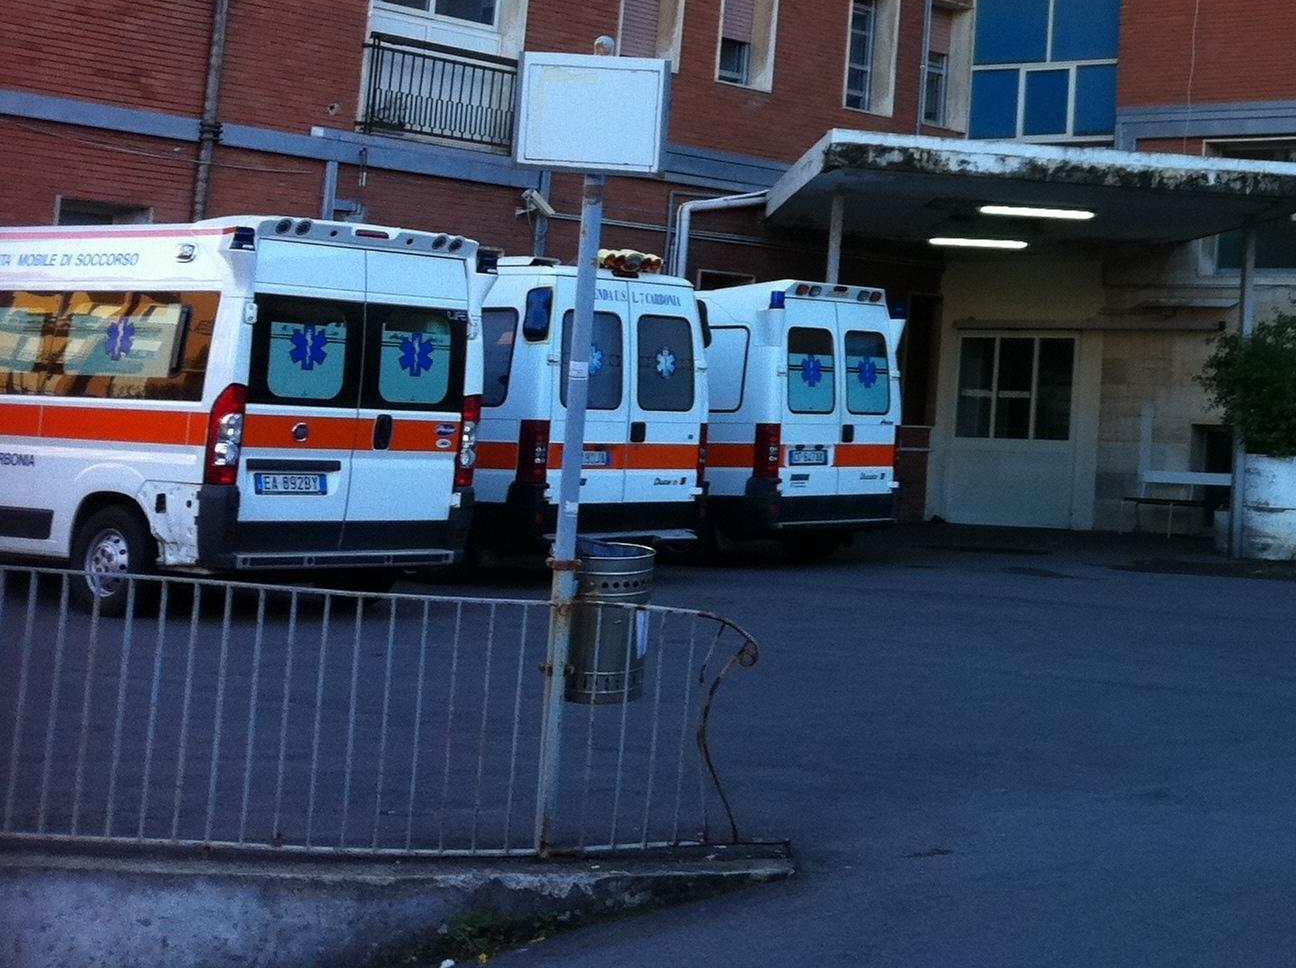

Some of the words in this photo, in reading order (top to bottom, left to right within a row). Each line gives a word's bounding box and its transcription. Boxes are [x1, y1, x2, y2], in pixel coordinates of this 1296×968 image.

[18, 253, 58, 267] MOBILE
[60, 253, 73, 266] DI
[75, 252, 140, 267] SOCCORSO
